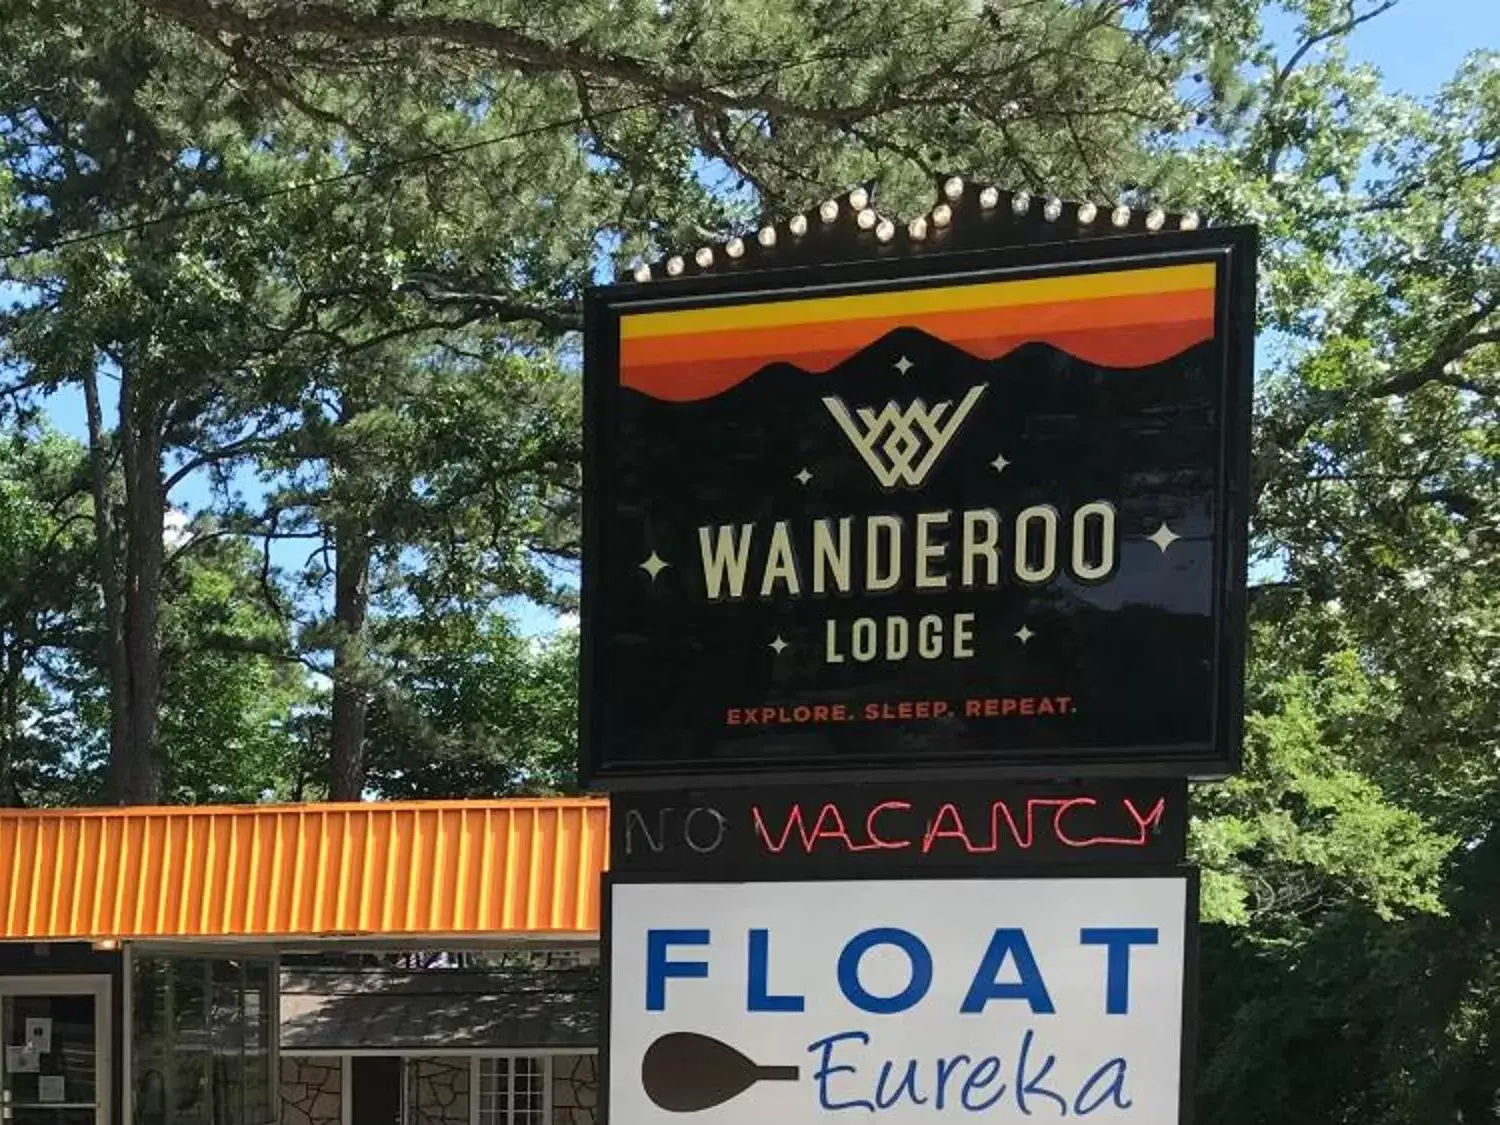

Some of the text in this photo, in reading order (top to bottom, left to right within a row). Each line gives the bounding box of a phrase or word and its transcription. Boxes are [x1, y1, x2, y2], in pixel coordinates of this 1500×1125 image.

[698, 501, 1117, 599] WANDEROO
[825, 613, 976, 663] LODGE
[726, 697, 1078, 725] EXPLORE. SLEEP. REPEAT.
[625, 797, 1164, 854] NO VACANCY
[644, 926, 1159, 1015] FLOAT
[807, 1029, 1133, 1117] Eureka
